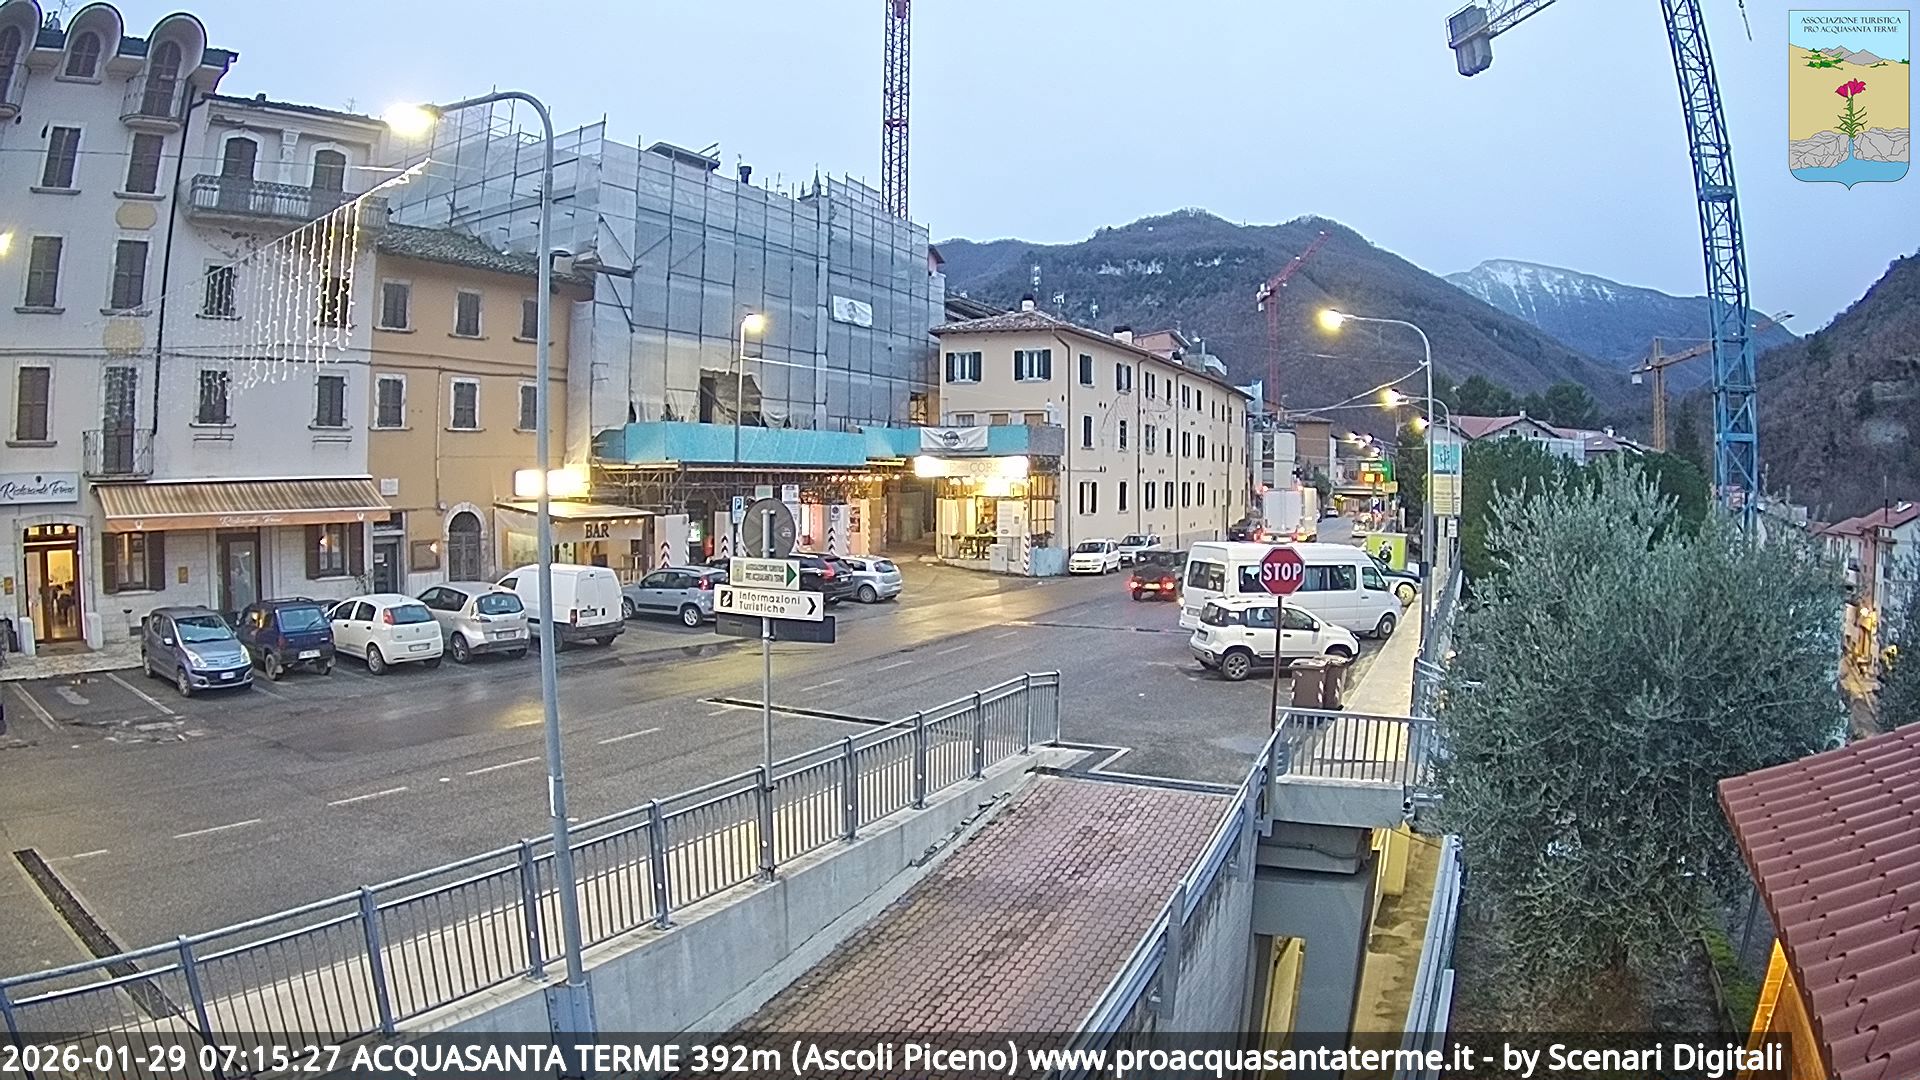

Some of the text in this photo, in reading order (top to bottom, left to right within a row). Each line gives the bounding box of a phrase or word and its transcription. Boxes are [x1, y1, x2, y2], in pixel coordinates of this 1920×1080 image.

[585, 523, 610, 538] BAR
[1263, 562, 1302, 581] STOP
[739, 591, 801, 604] Informazioni
[739, 600, 785, 614] Turistiche
